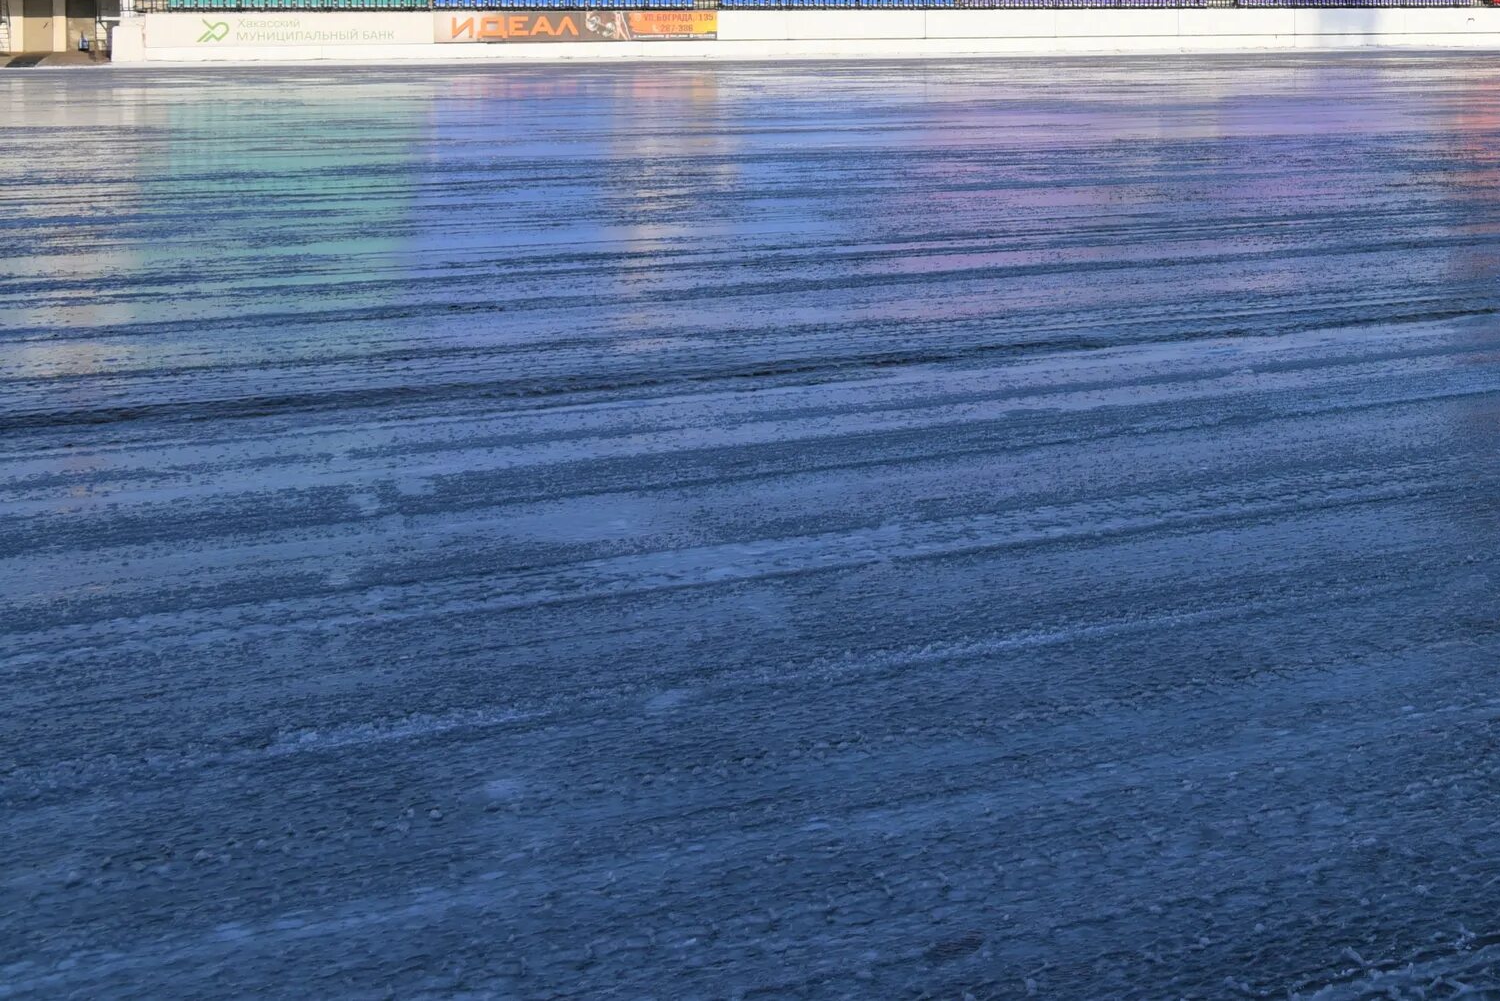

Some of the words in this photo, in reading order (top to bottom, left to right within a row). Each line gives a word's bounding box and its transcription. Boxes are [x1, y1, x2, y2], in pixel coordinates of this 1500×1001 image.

[237, 18, 301, 28] Хакасский
[451, 14, 579, 38] ИДЕАЛ
[236, 28, 359, 42] МУНИЦИПАЛЬНЫЙ
[362, 30, 395, 40] БАНК
